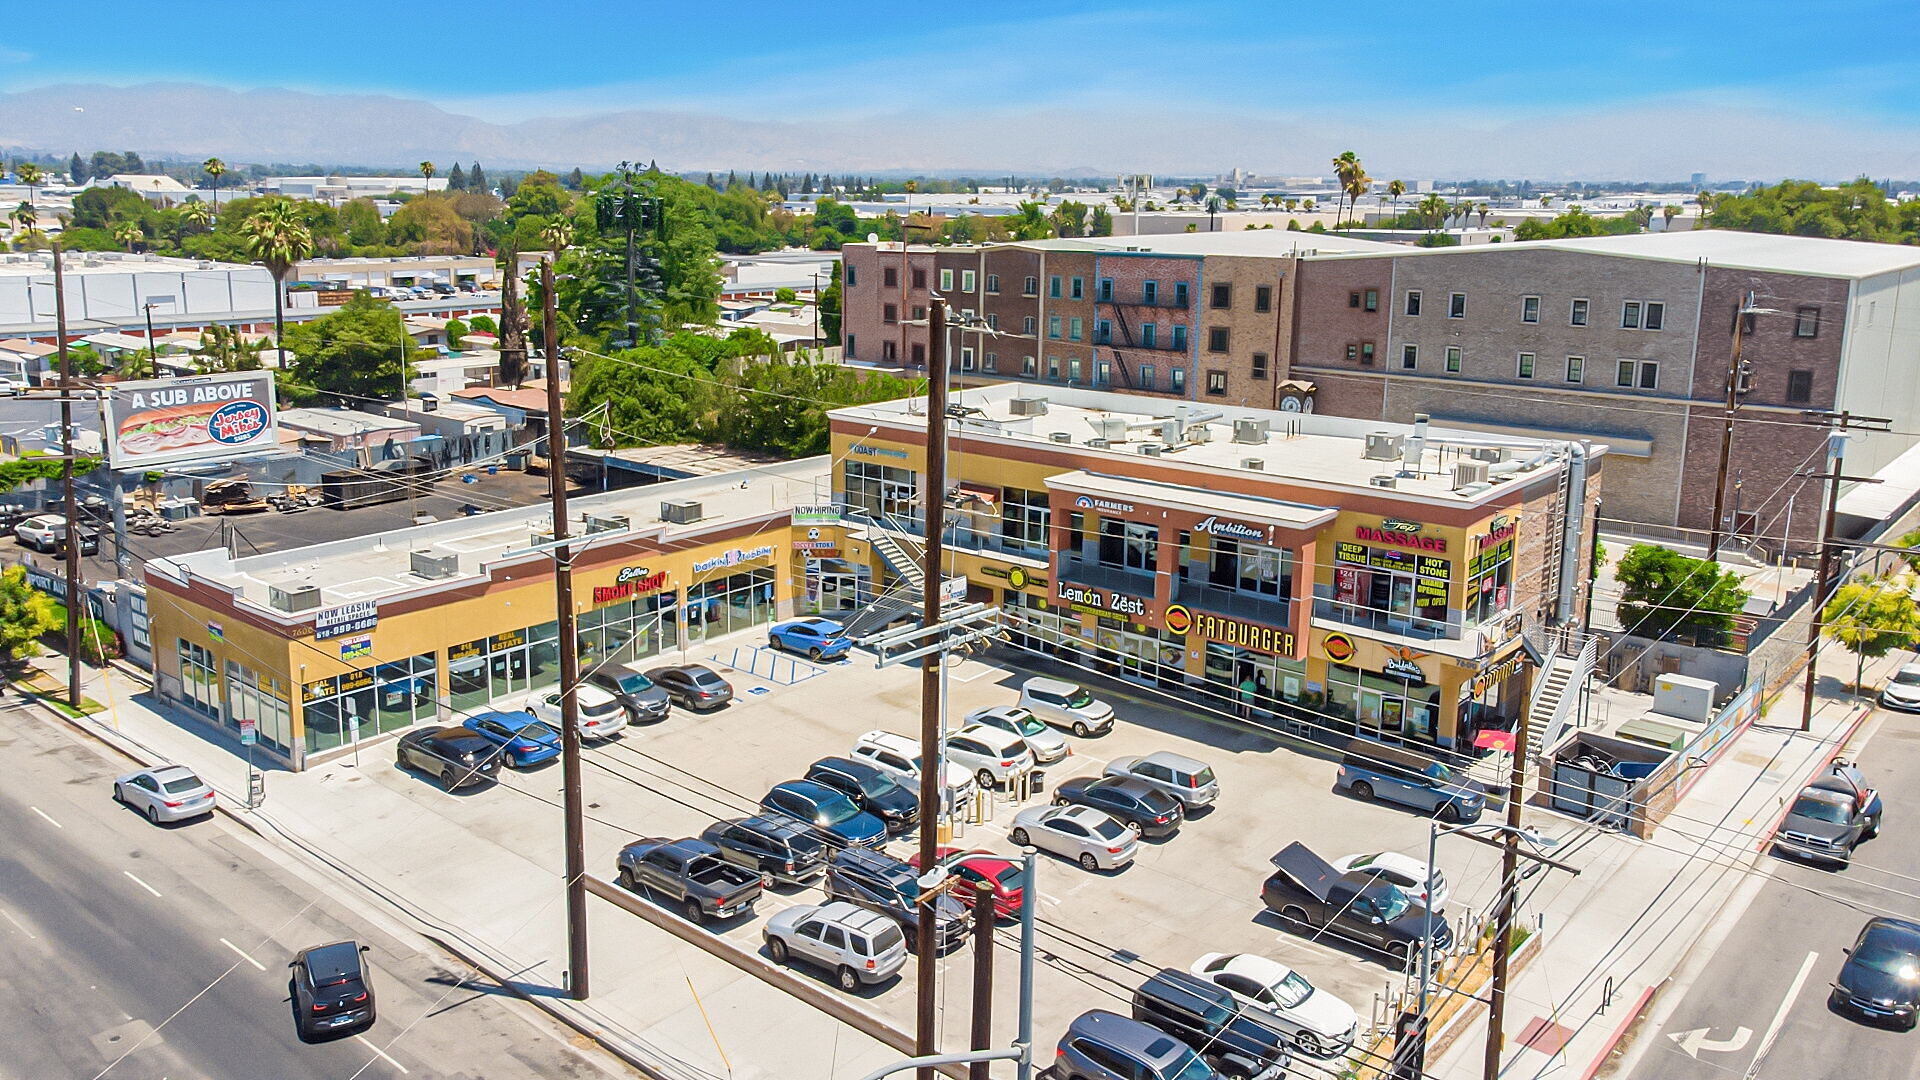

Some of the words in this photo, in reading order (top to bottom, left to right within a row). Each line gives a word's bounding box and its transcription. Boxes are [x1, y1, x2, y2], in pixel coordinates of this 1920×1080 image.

[132, 394, 145, 408] A
[151, 389, 187, 407] SUB
[194, 383, 253, 402] ABOVE
[216, 408, 259, 427] Jersey
[795, 505, 813, 515] NOW
[814, 505, 840, 515] HIRING
[1094, 500, 1134, 512] FARMERS
[1194, 517, 1263, 538] Ambition
[1356, 527, 1446, 552] MASSAGE
[1342, 543, 1363, 553] DEEP
[1338, 552, 1366, 564] TISSUE
[1425, 558, 1443, 568] HOT
[1420, 567, 1448, 579] STONE
[594, 582, 633, 603] SMOKE
[637, 571, 666, 592] SHOP
[1417, 585, 1446, 597] OPENING
[1417, 598, 1429, 607] NOW
[1431, 597, 1446, 606] OPEN
[318, 609, 338, 621] NOW
[341, 600, 377, 615] LEASING
[1197, 614, 1294, 656] FATBURGER
[492, 637, 523, 651] ESTATE
[303, 686, 336, 702] ESATE
